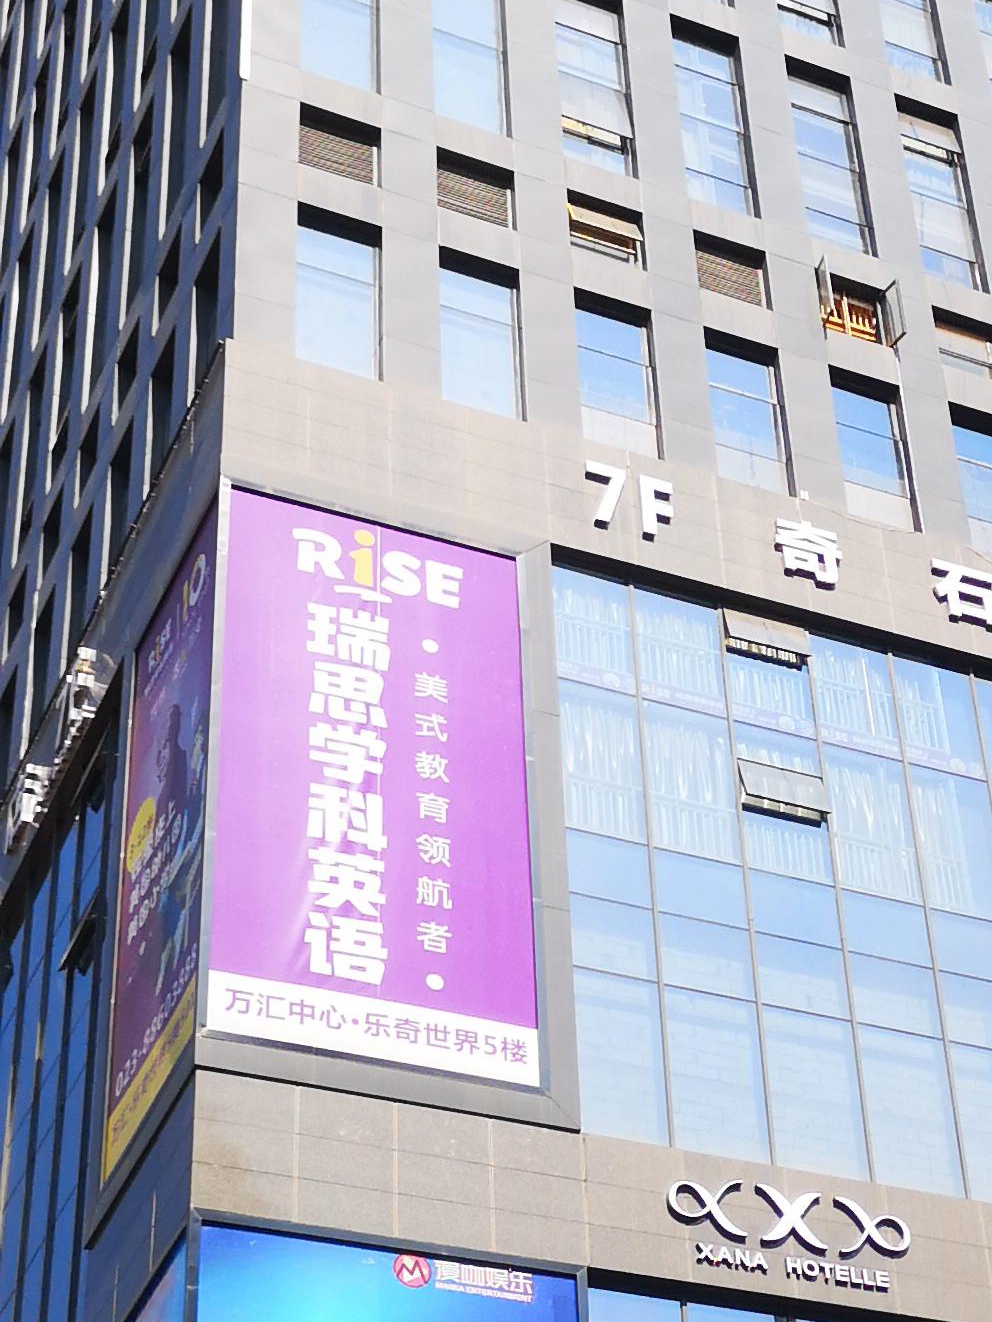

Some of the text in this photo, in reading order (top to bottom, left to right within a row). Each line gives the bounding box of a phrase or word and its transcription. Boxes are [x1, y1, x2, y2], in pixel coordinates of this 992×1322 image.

[583, 461, 675, 543] 7F
[305, 601, 391, 988] 瑞思学科英语
[413, 669, 453, 956] 美式教育领航者
[695, 1241, 891, 1294] XANA HOTELLE
